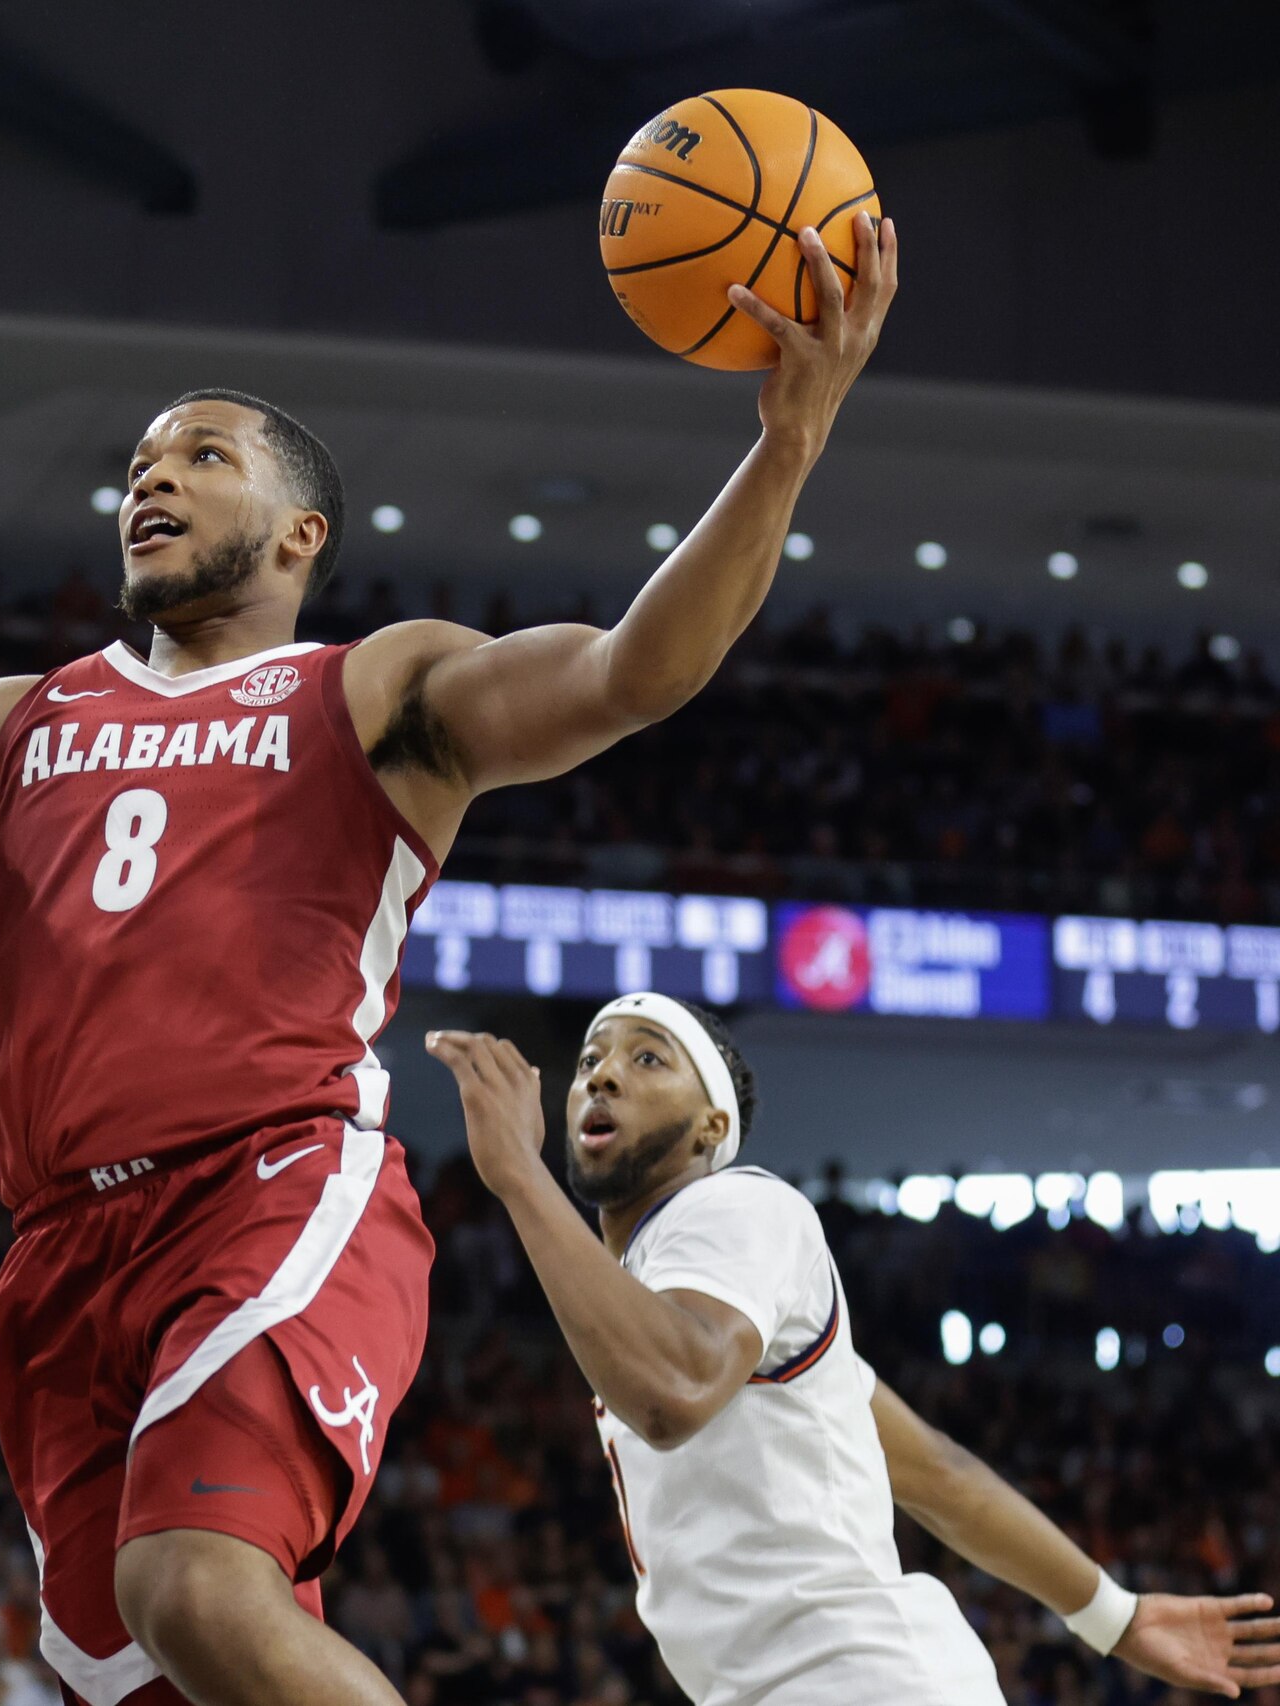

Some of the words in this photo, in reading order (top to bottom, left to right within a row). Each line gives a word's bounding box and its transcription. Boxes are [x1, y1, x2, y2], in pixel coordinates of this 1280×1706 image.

[634, 202, 663, 216] NXT
[247, 667, 294, 697] SEC
[22, 715, 291, 788] ALABAMA
[92, 788, 168, 913] 8
